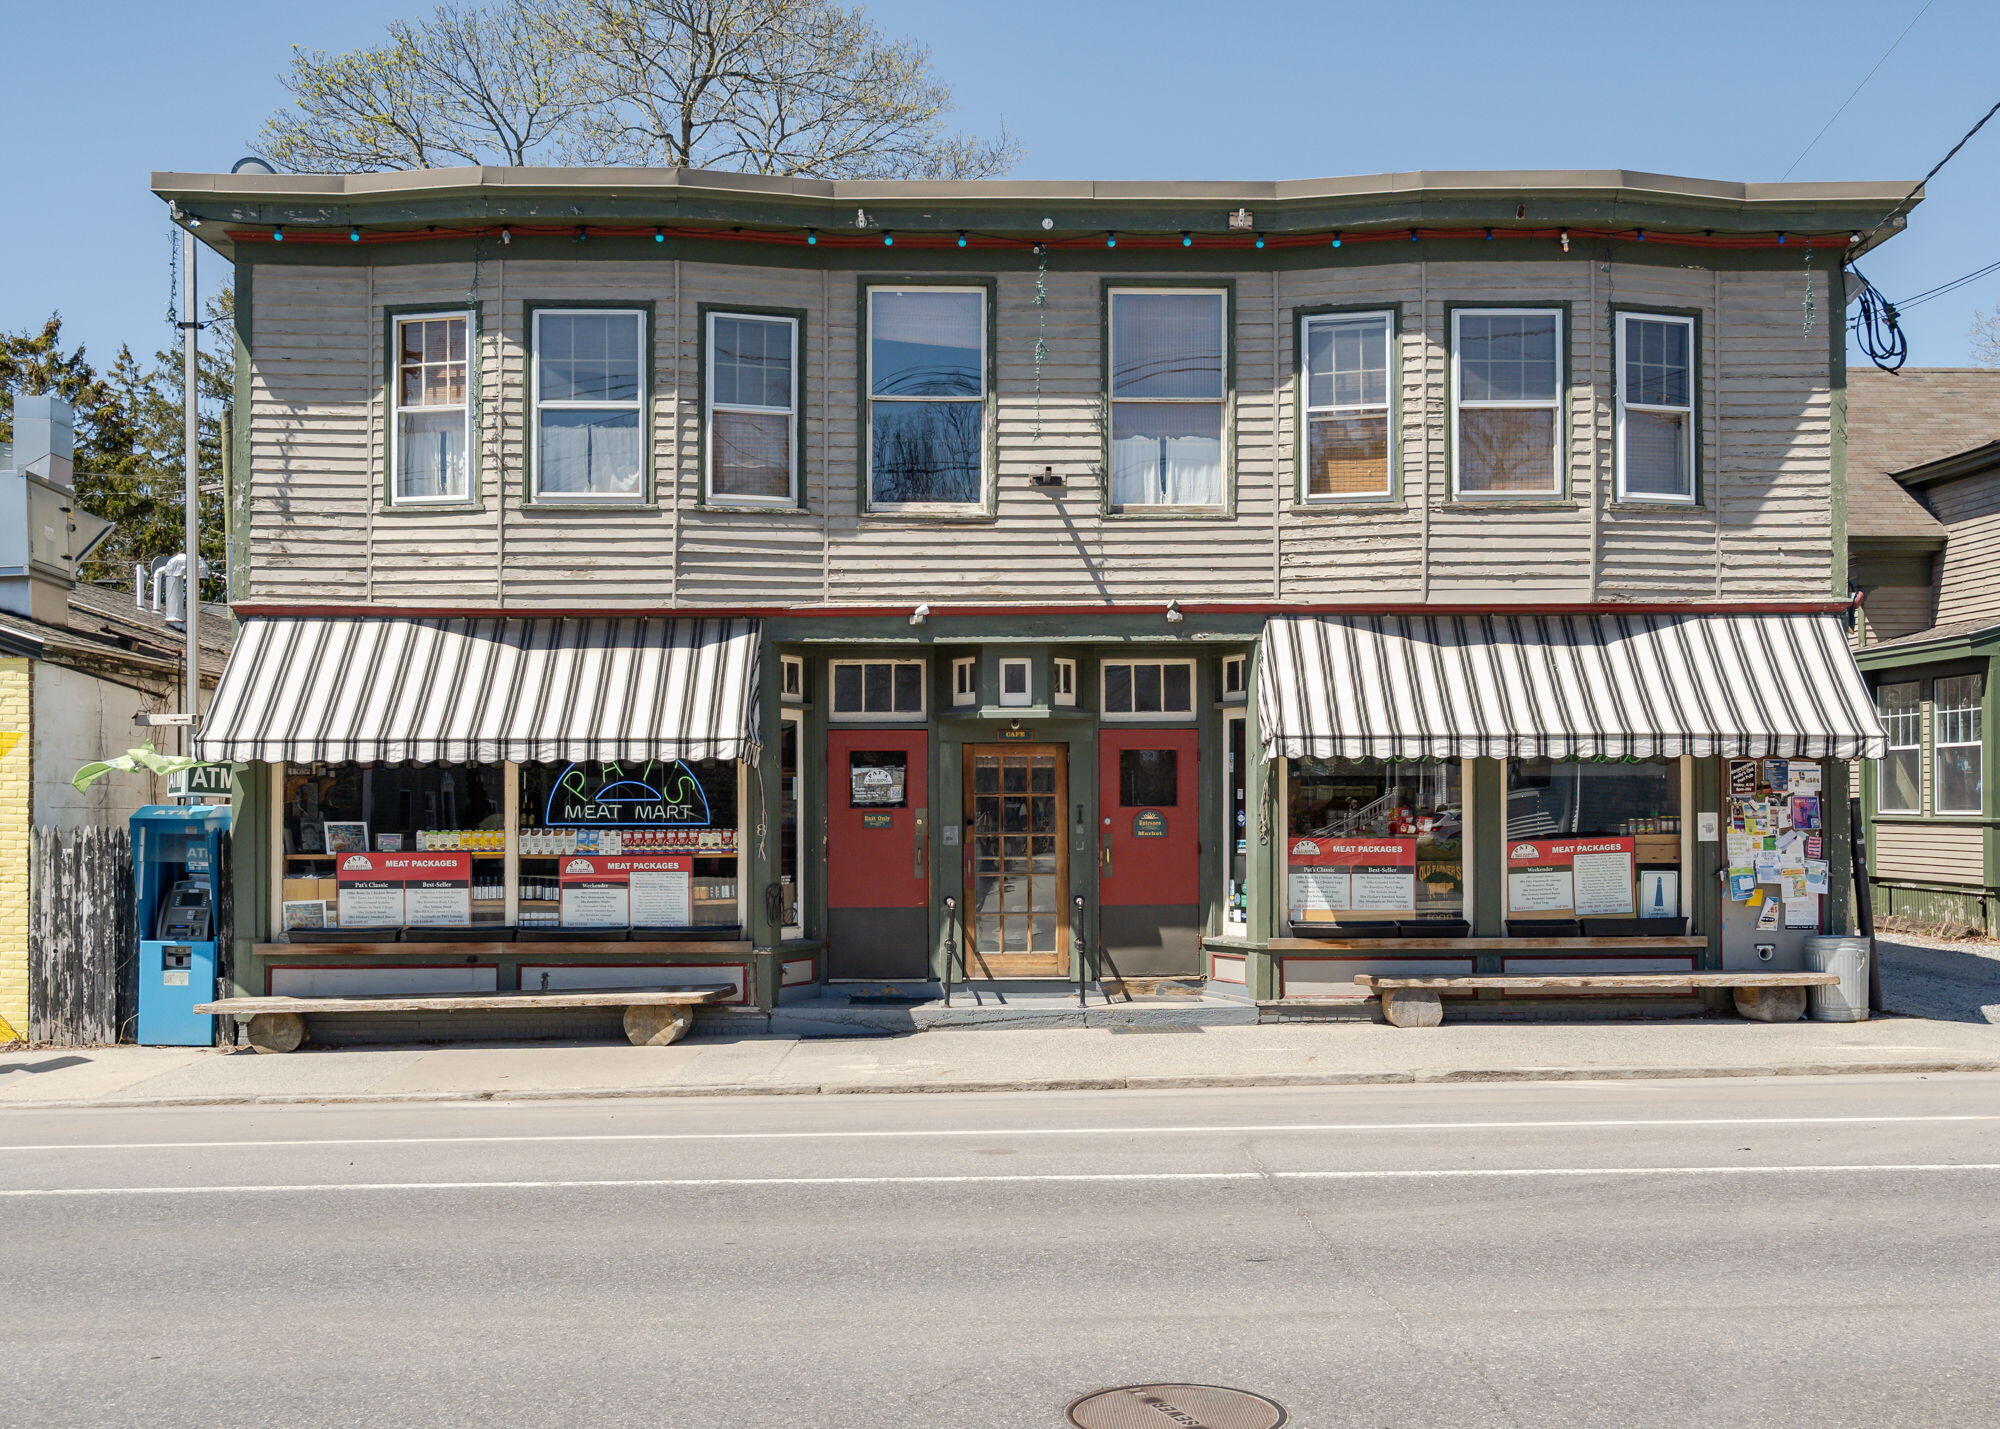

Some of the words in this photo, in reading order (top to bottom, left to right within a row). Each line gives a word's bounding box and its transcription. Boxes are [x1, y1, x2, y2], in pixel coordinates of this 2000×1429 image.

[191, 766, 233, 789] ATM
[564, 804, 623, 819] MEAT
[635, 804, 693, 819] MART
[1551, 845, 1575, 854] MEAT
[1576, 843, 1622, 853] PACKAGES
[1152, 1402, 1199, 1426] SEWER
